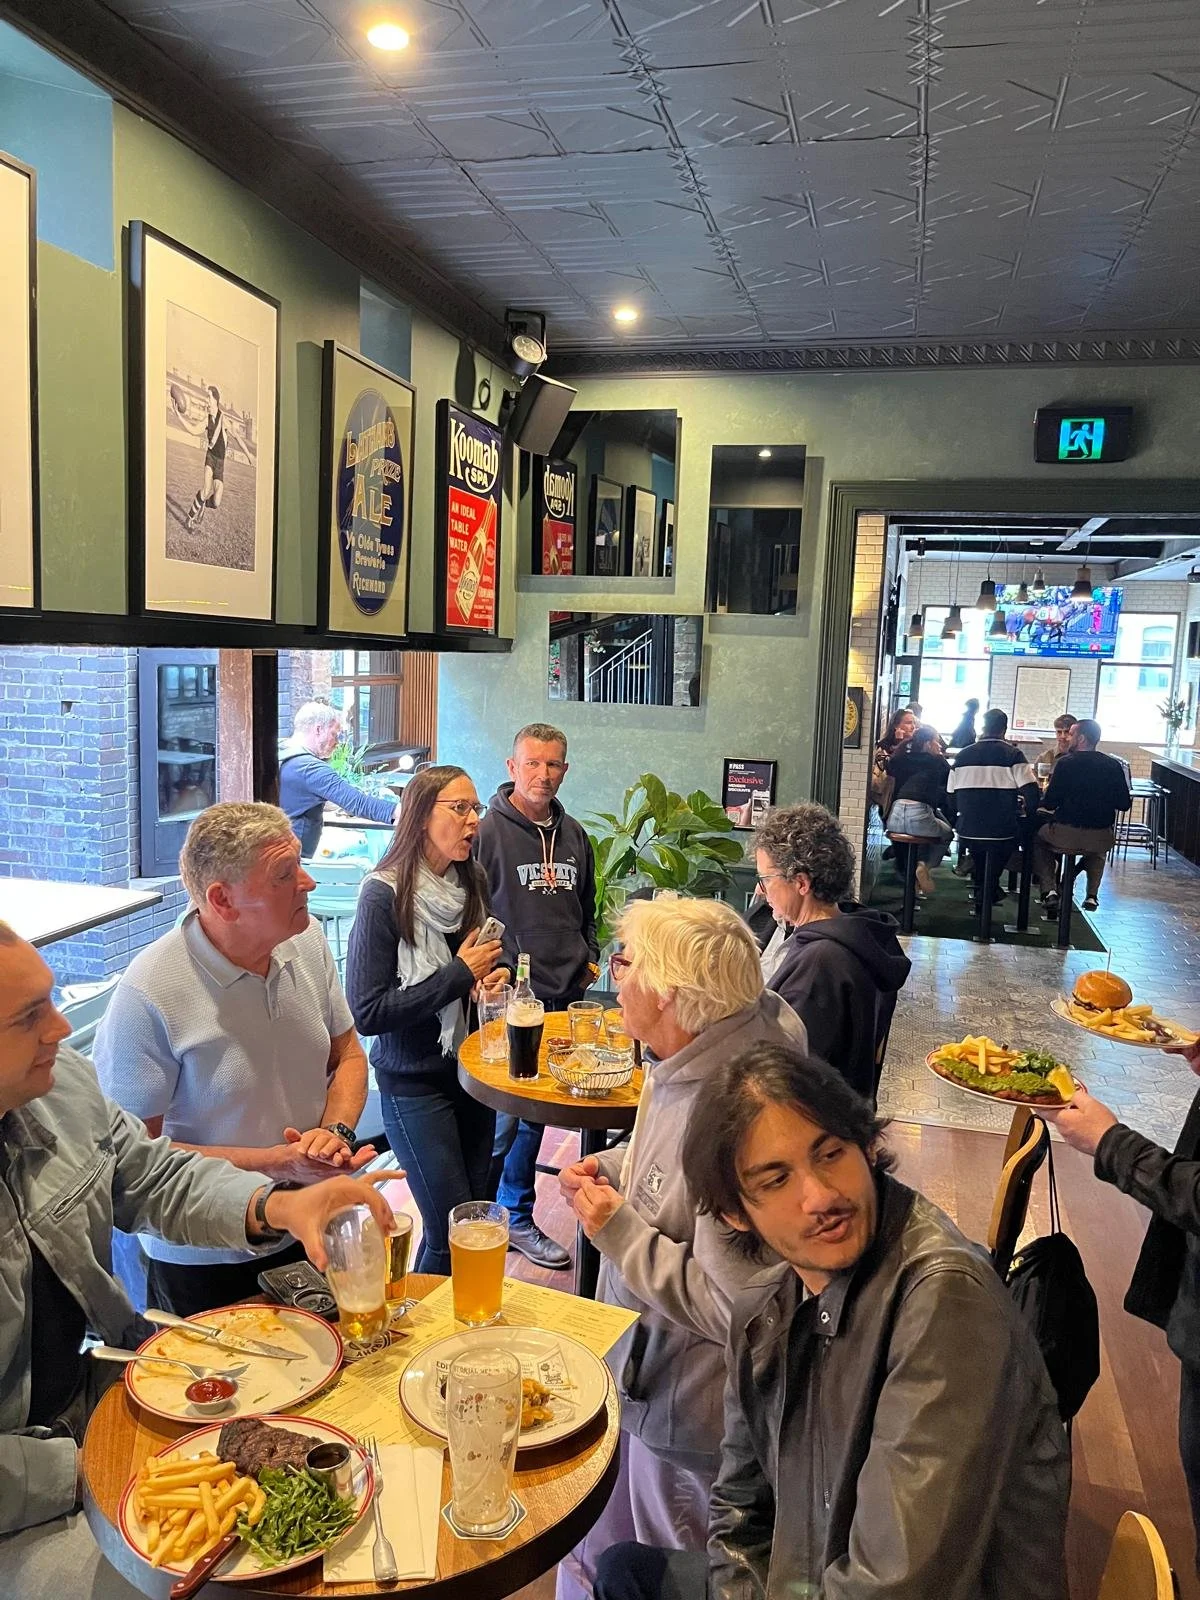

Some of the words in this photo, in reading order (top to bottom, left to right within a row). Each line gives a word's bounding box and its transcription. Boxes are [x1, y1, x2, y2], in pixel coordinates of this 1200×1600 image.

[449, 418, 499, 484] Koomah
[370, 459, 400, 484] PRIZE
[470, 468, 489, 487] SPA
[352, 473, 393, 526] ALE
[451, 501, 459, 514] AN
[460, 504, 476, 520] IDEAL
[451, 519, 469, 535] TABLE
[449, 537, 468, 552] WATER
[728, 776, 764, 784] Exclusive
[517, 863, 540, 885] VIC
